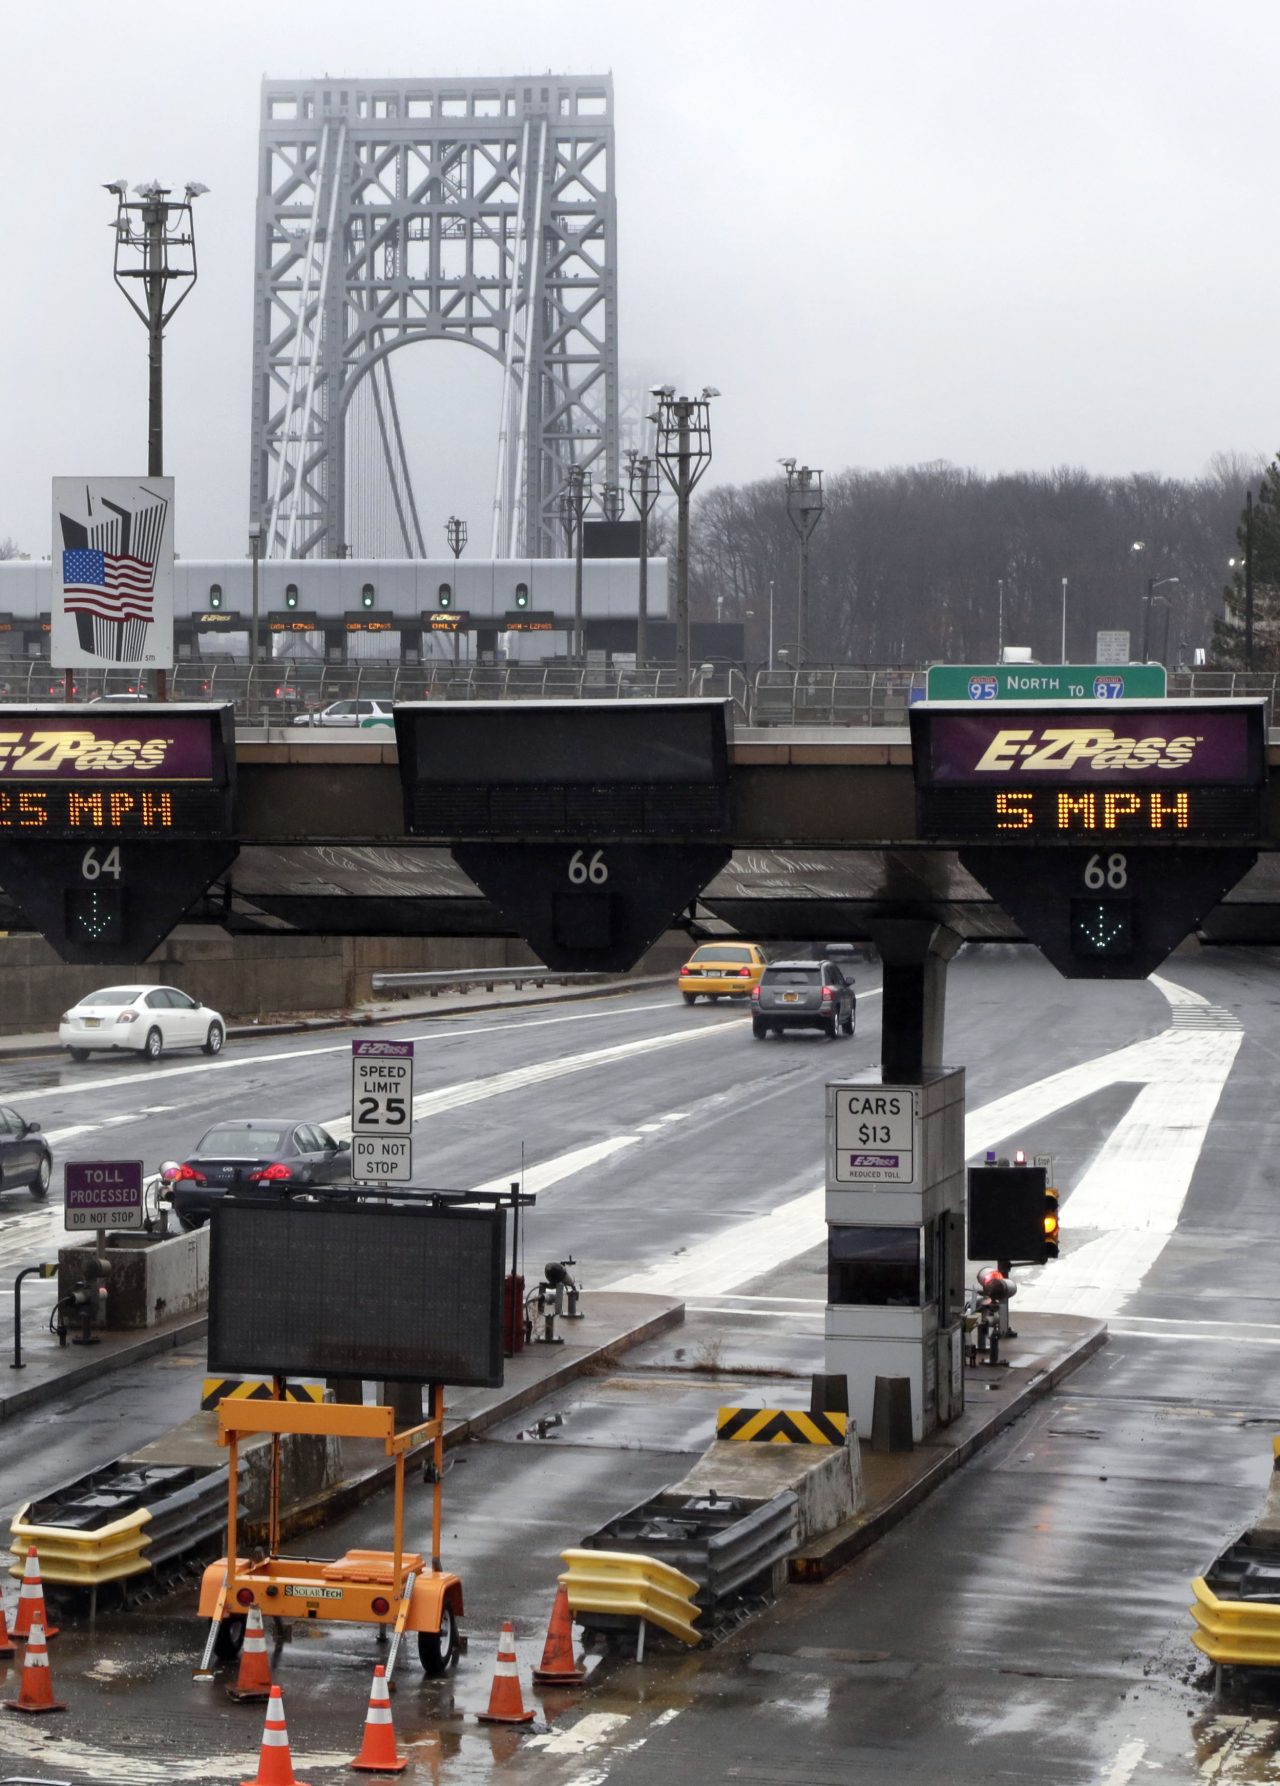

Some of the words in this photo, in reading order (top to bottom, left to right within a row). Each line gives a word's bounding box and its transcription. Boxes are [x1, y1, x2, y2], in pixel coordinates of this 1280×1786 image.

[970, 684, 996, 700] 95
[1096, 683, 1121, 699] 87
[974, 728, 1197, 772] E-ZPass
[69, 793, 172, 827] MPH
[996, 793, 1034, 829] 5
[1057, 792, 1190, 829] MPH
[81, 846, 121, 881] 64
[568, 849, 608, 884] 66
[1084, 853, 1128, 890] 68
[360, 1065, 406, 1078] SPEED
[364, 1081, 401, 1093] LIMIT
[358, 1097, 406, 1125] 25
[848, 1097, 900, 1115] CARS
[858, 1122, 891, 1145] $13
[358, 1143, 375, 1155] DO
[382, 1144, 406, 1156] NOT
[84, 1170, 124, 1183] TOLL
[366, 1162, 398, 1174] STOP
[849, 1170, 881, 1178] REDUCED
[884, 1171, 901, 1179] TOLL
[70, 1188, 138, 1203] PROCESSED
[73, 1213, 86, 1224] DO
[90, 1212, 108, 1223] NOT
[111, 1211, 134, 1223] STOP
